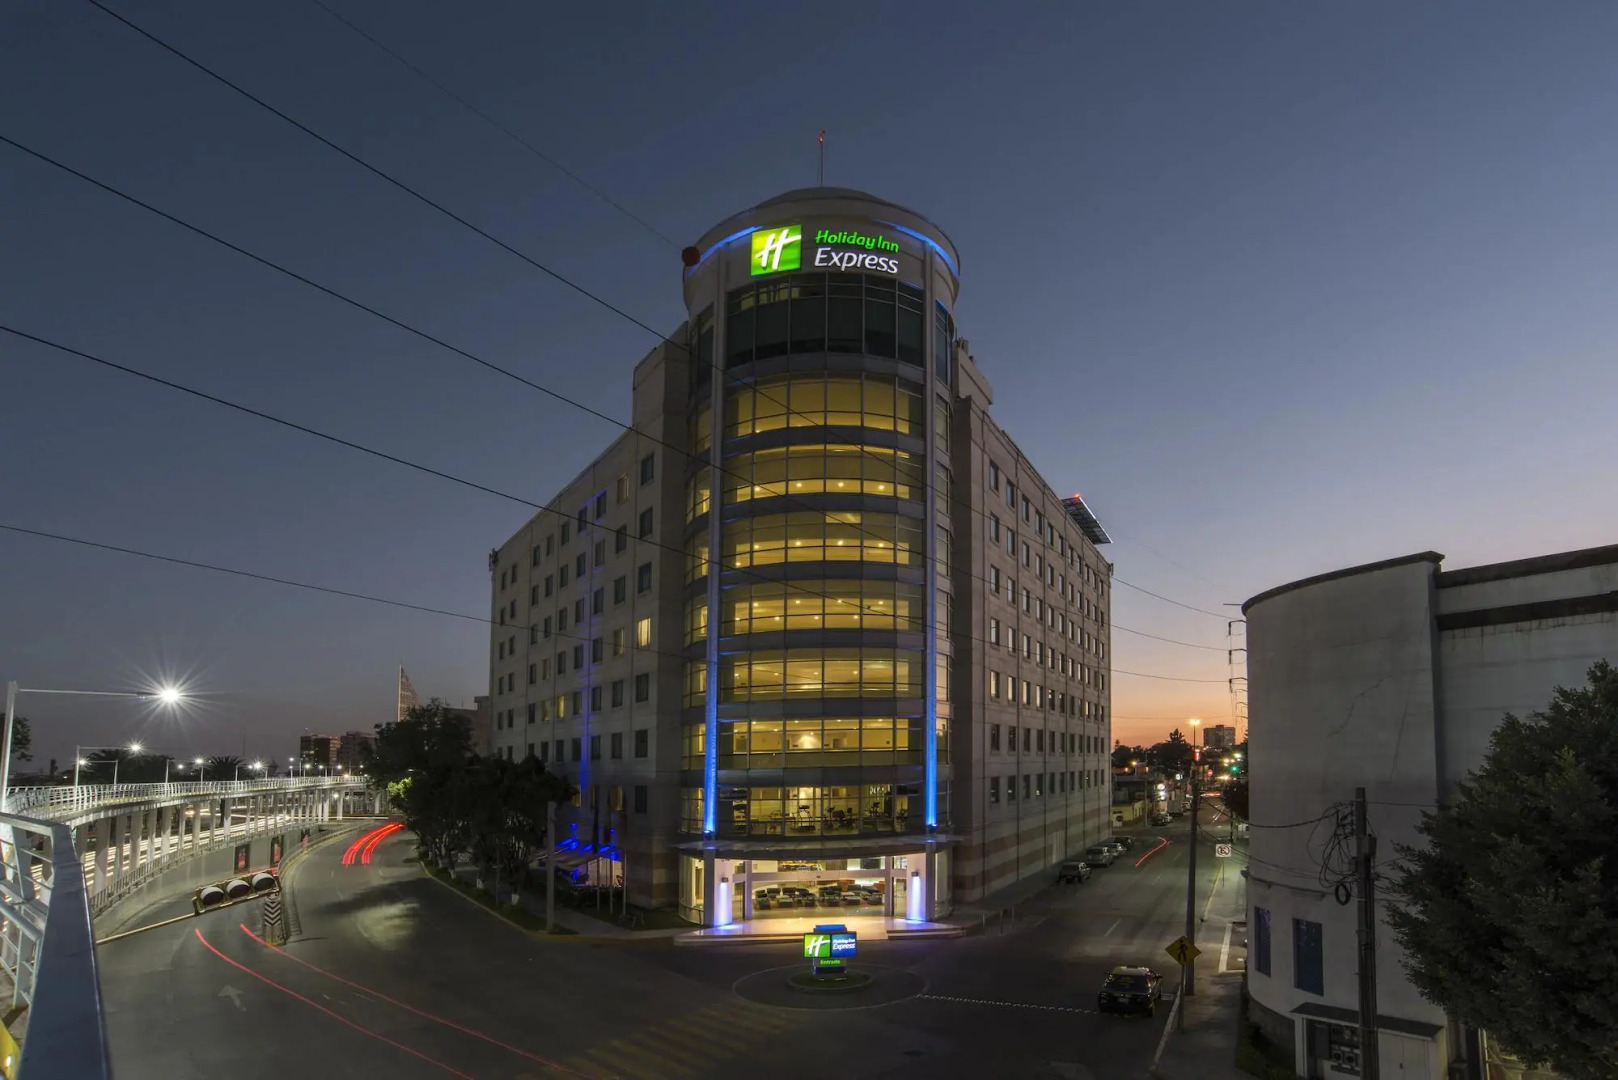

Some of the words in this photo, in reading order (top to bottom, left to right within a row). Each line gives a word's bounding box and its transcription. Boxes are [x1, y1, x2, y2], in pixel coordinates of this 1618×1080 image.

[815, 229, 875, 250] Holiday
[877, 235, 900, 253] Inn
[814, 247, 899, 274] Express
[832, 943, 856, 951] Express
